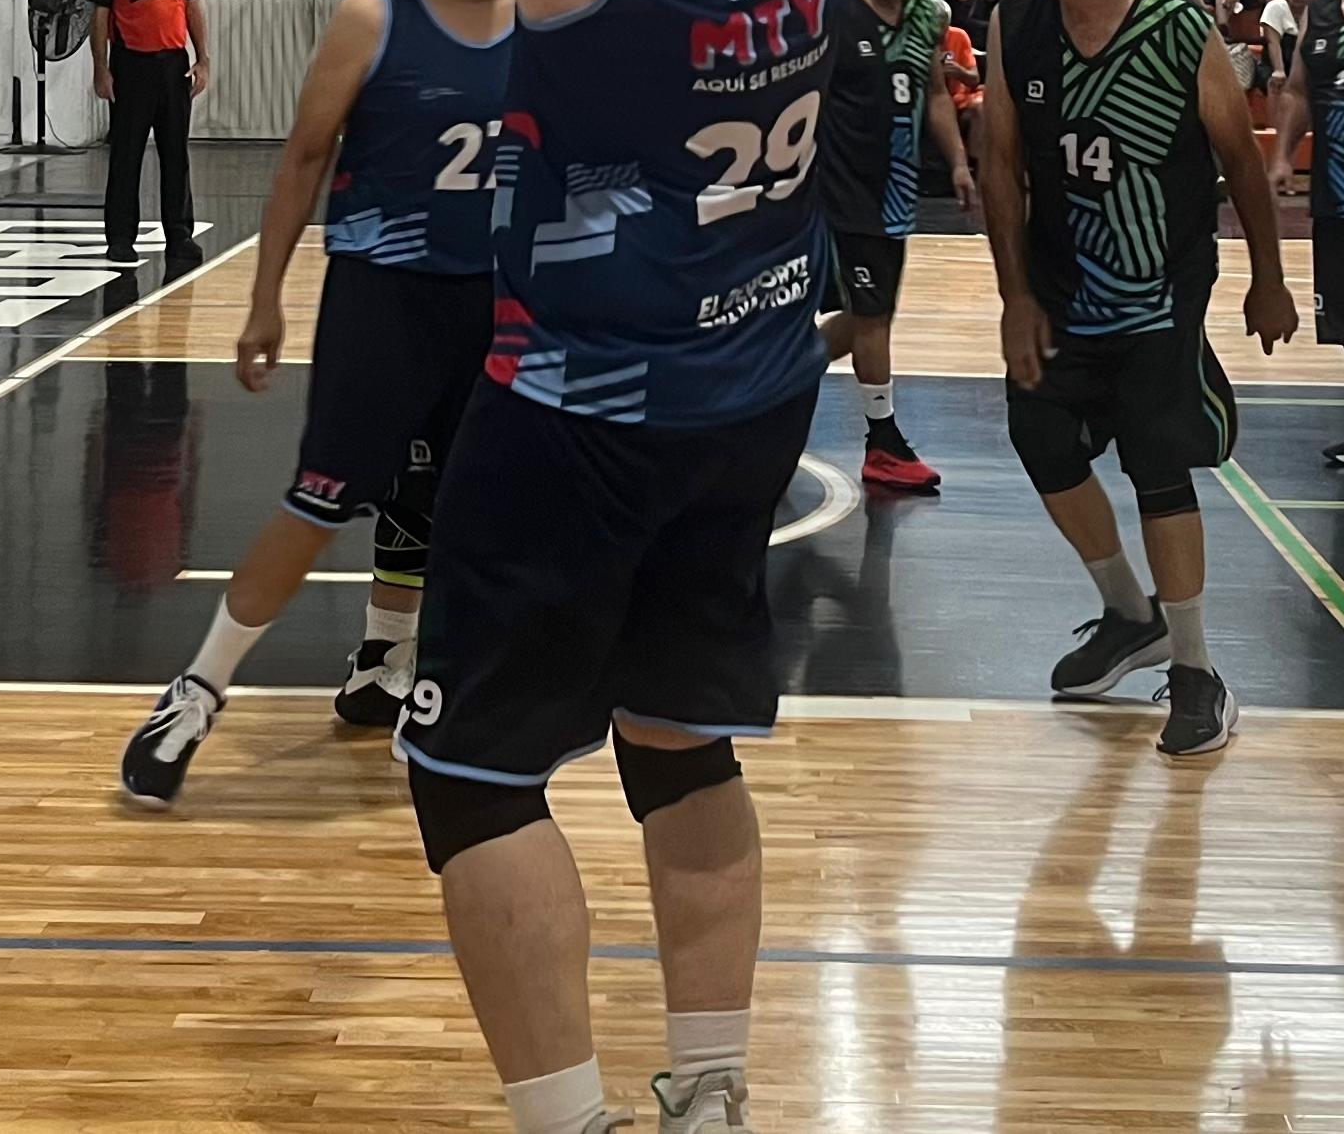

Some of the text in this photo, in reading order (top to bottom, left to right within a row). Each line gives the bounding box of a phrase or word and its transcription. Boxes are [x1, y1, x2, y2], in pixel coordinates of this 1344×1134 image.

[749, 69, 769, 91] SE
[892, 72, 911, 104] 8
[685, 90, 821, 226] 29
[1059, 132, 1114, 183] 14
